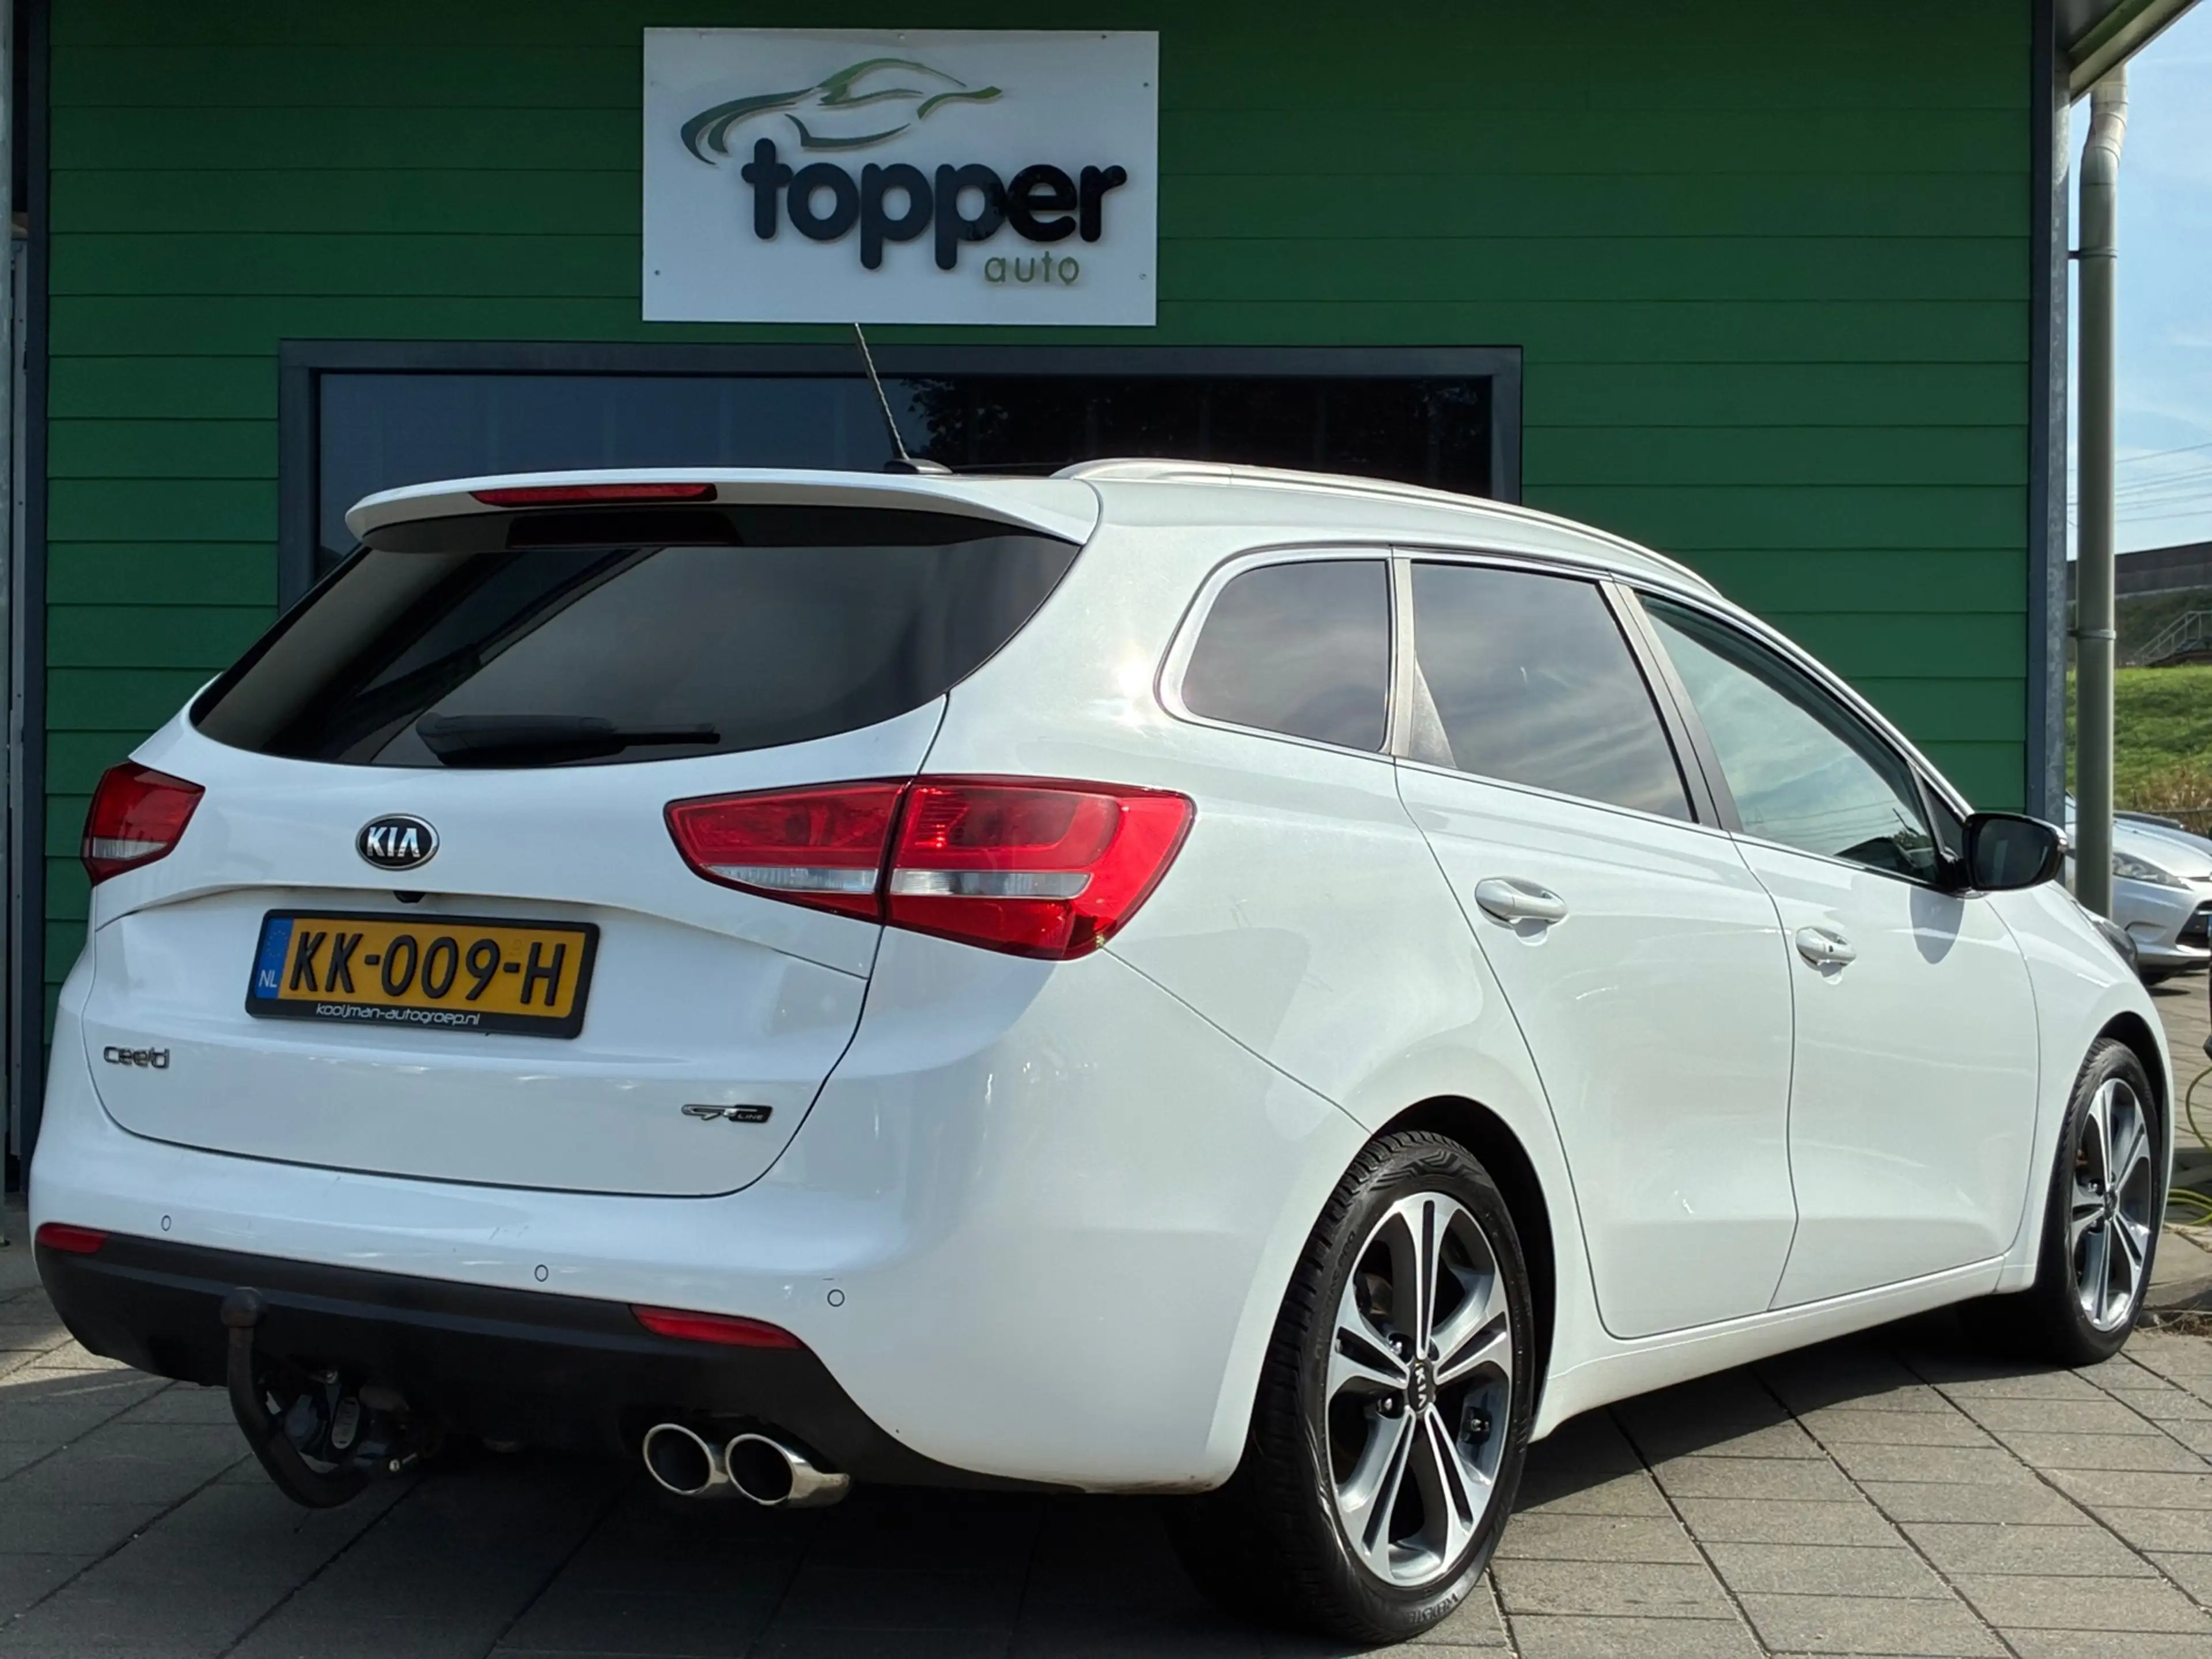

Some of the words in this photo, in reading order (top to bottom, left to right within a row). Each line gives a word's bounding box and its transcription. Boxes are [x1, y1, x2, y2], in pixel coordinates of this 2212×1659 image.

[741, 138, 1127, 271] topper
[984, 250, 1079, 285] auto
[367, 827, 421, 858] KIA
[259, 969, 278, 988] NL
[289, 931, 567, 1006] KK-009-H
[316, 1003, 480, 1026] kooijman-autogroep.nl
[1415, 1367, 1427, 1408] KIA
